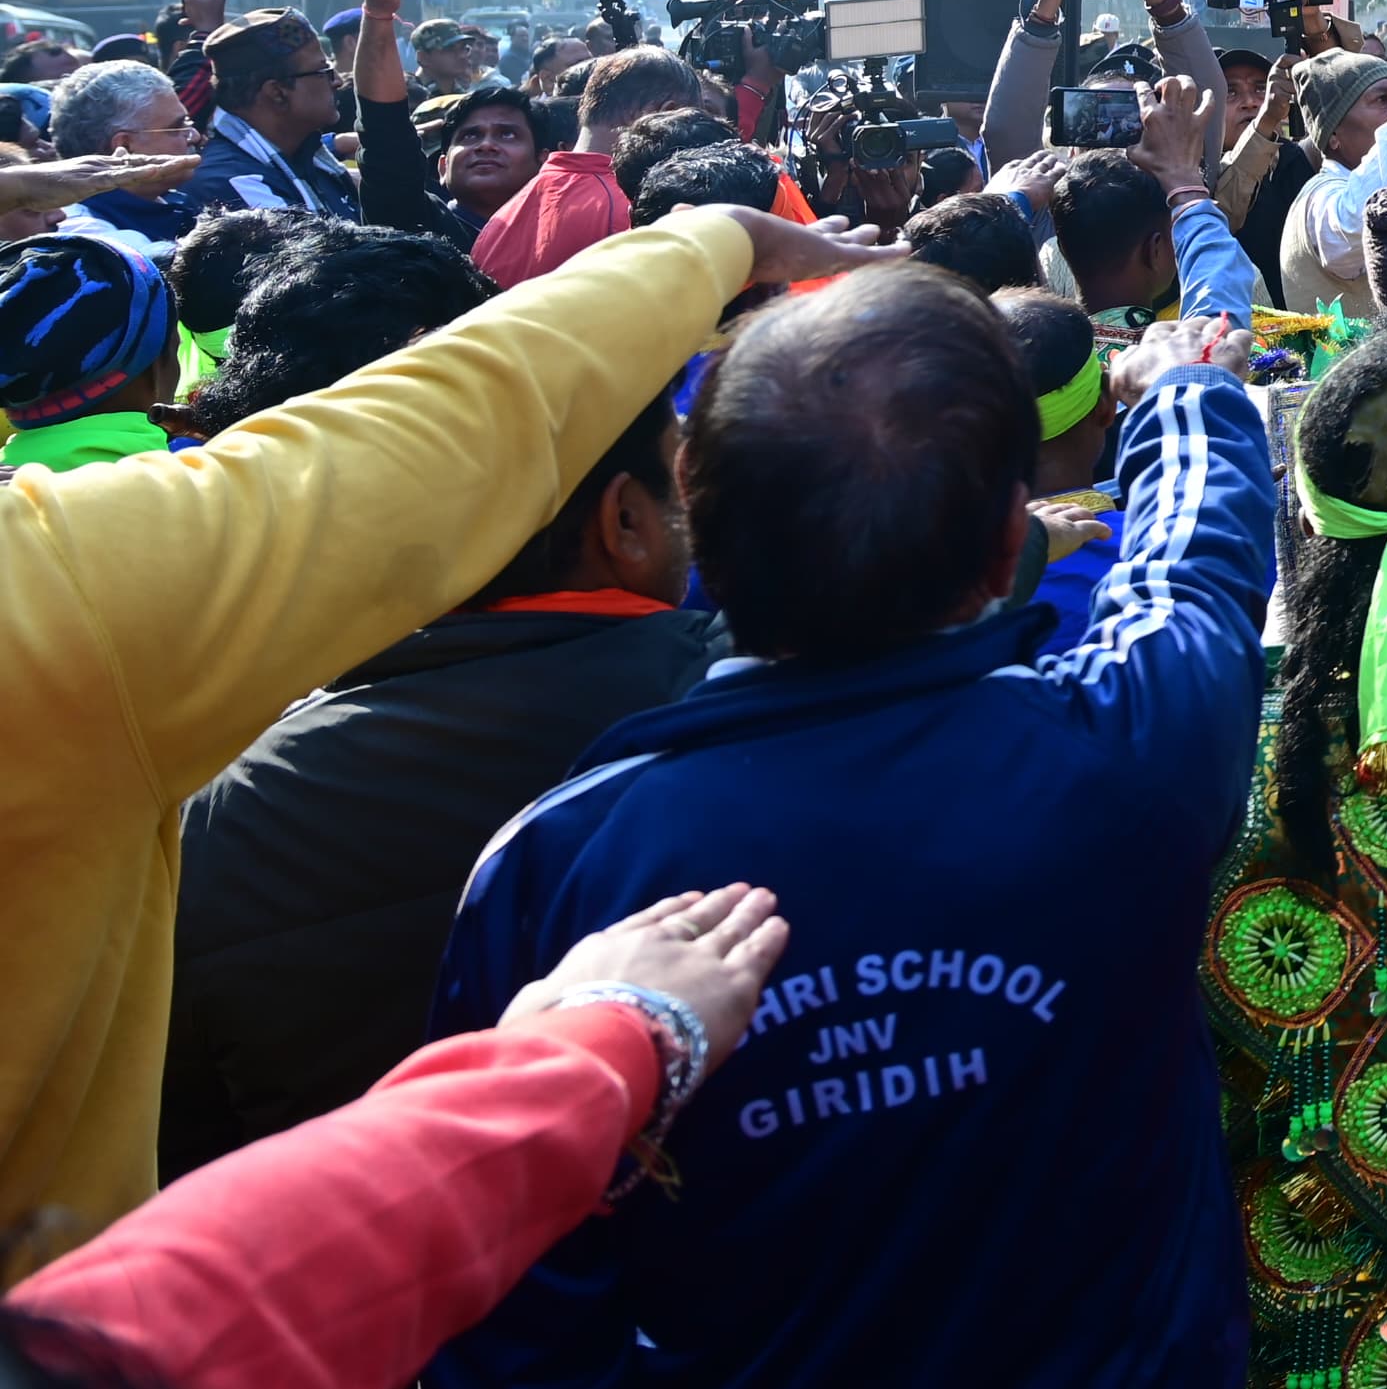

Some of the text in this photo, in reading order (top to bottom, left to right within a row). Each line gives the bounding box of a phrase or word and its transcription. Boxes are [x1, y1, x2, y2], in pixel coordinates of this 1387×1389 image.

[735, 949, 1067, 1050] HRI SCHOOL
[808, 1012, 898, 1065] JNV
[738, 1046, 989, 1139] GIRIDIH
